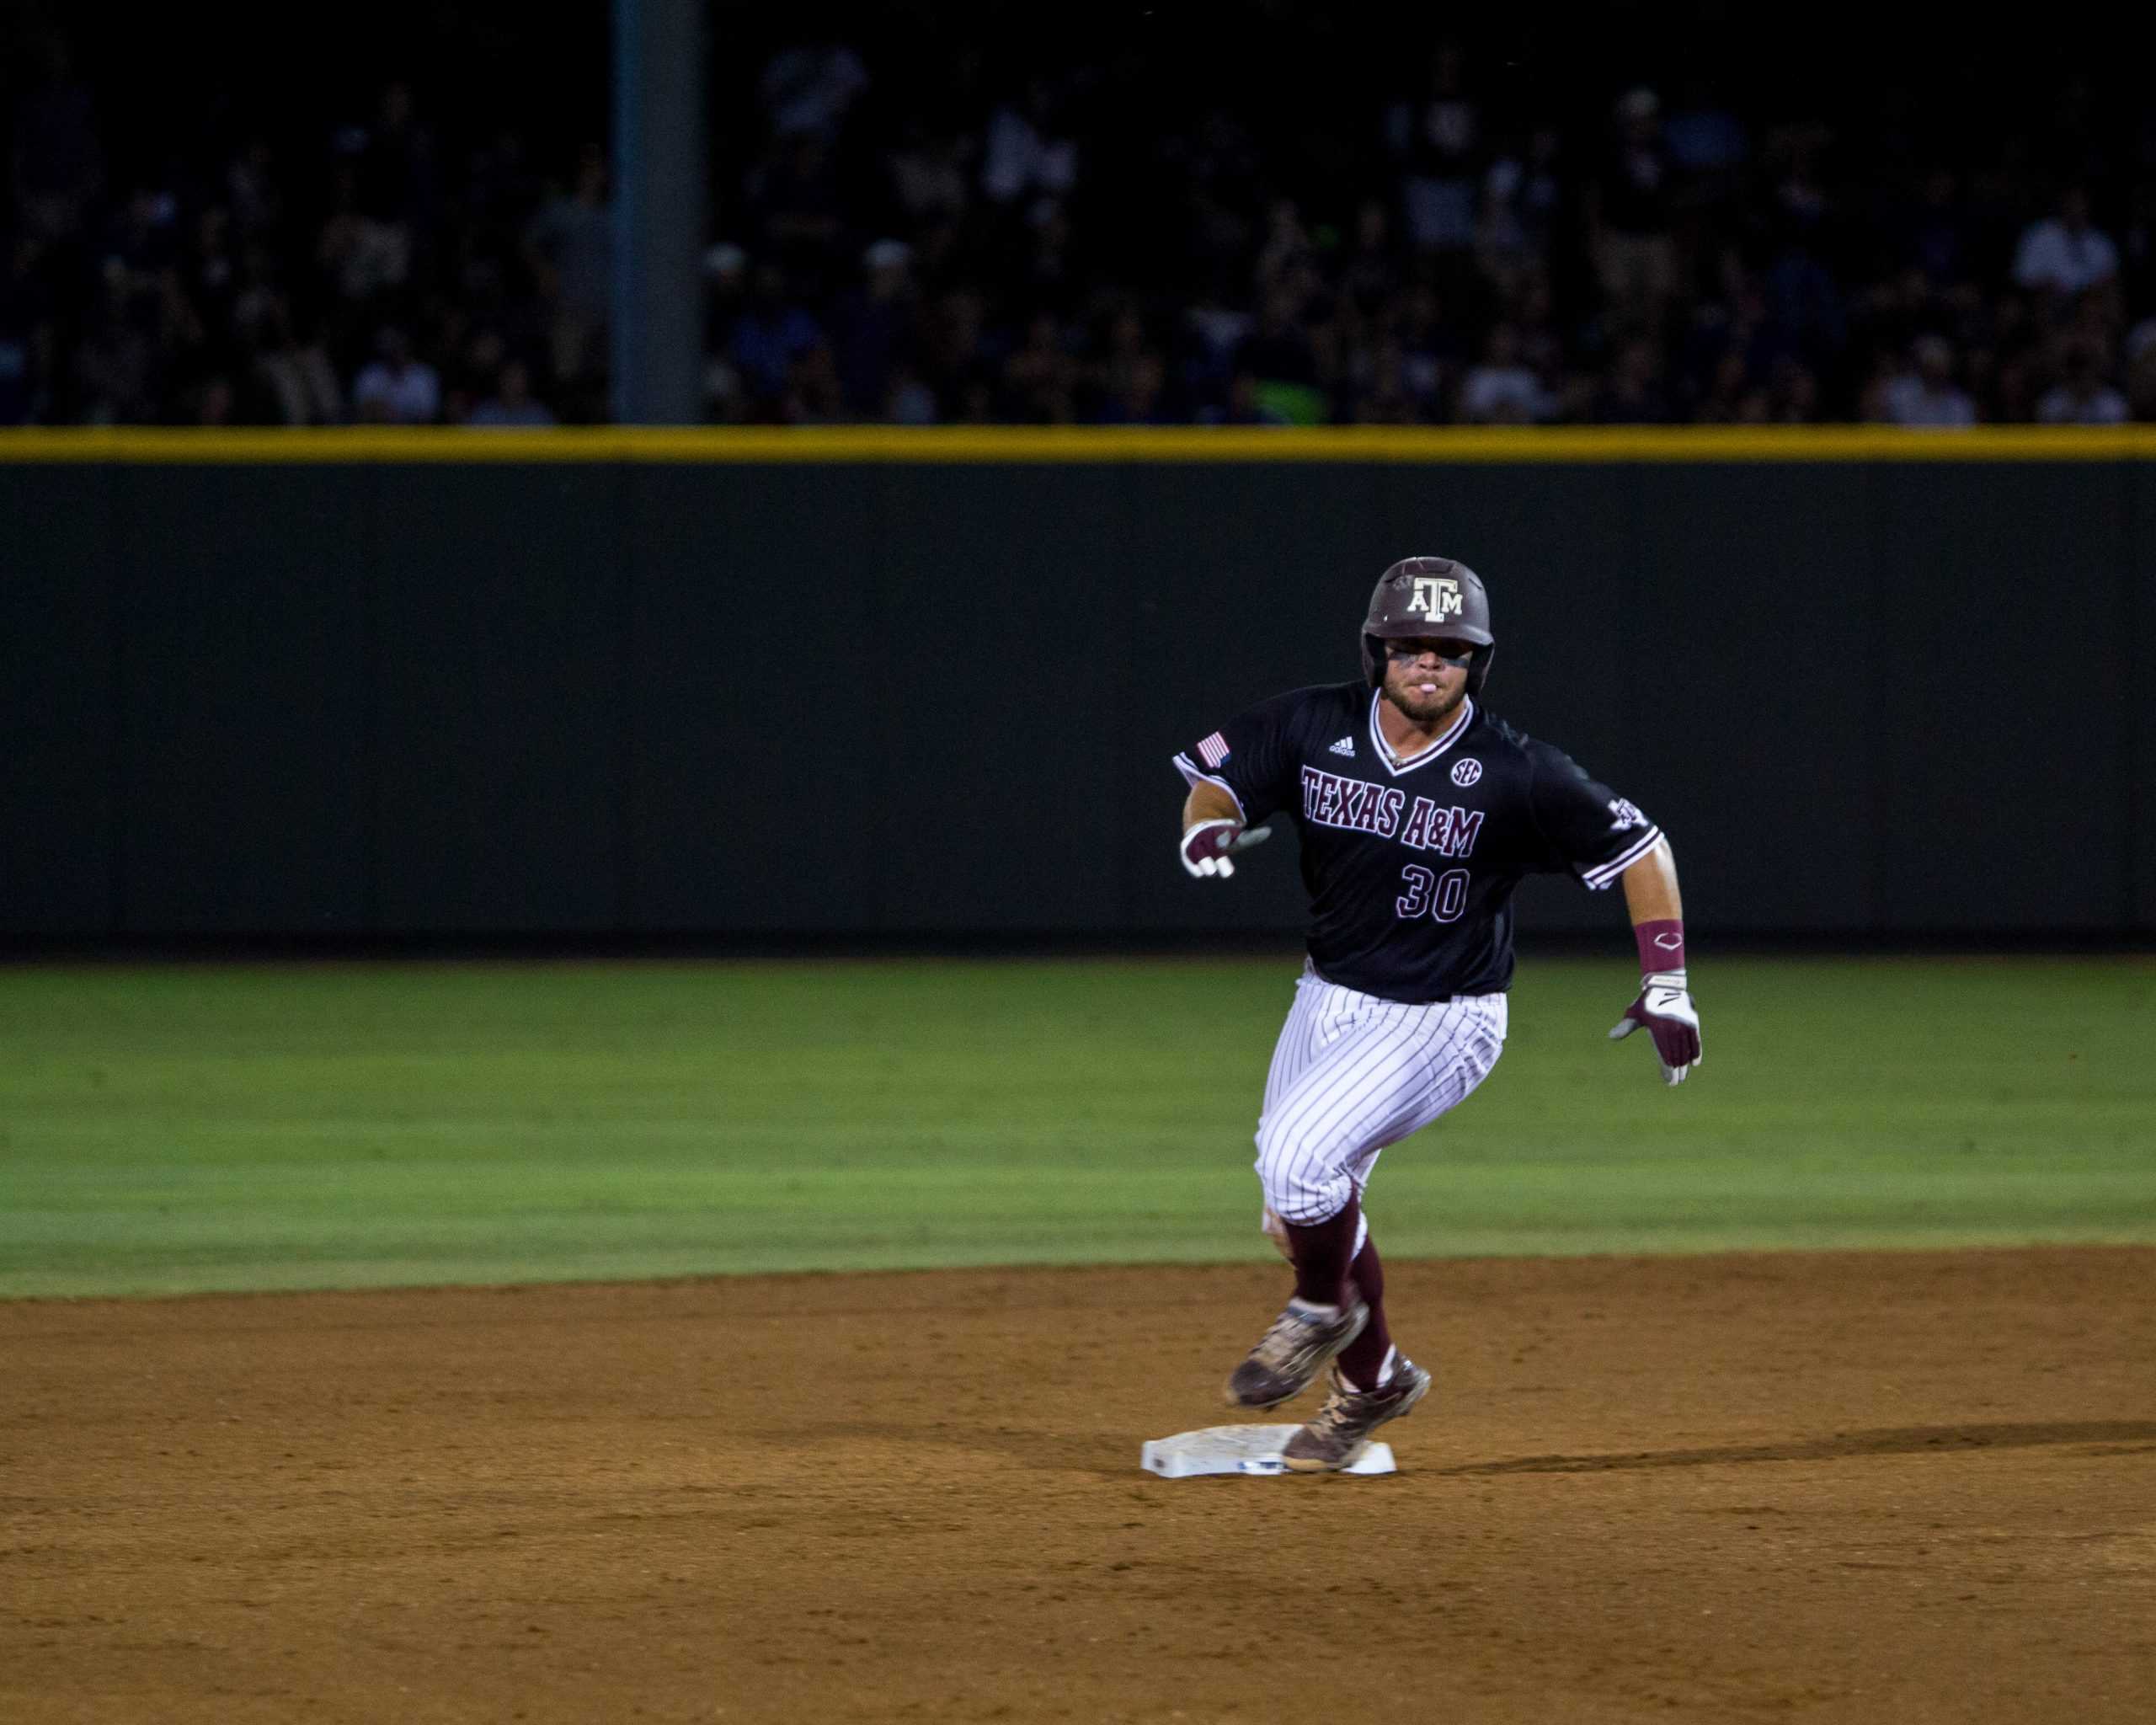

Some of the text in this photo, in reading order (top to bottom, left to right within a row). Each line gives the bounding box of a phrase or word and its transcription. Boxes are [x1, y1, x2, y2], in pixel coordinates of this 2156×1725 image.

[1329, 745, 1356, 756] adidas
[1453, 759, 1481, 785] SEC
[1301, 765, 1485, 857] TEXAS A&M
[1396, 863, 1470, 923] 30
